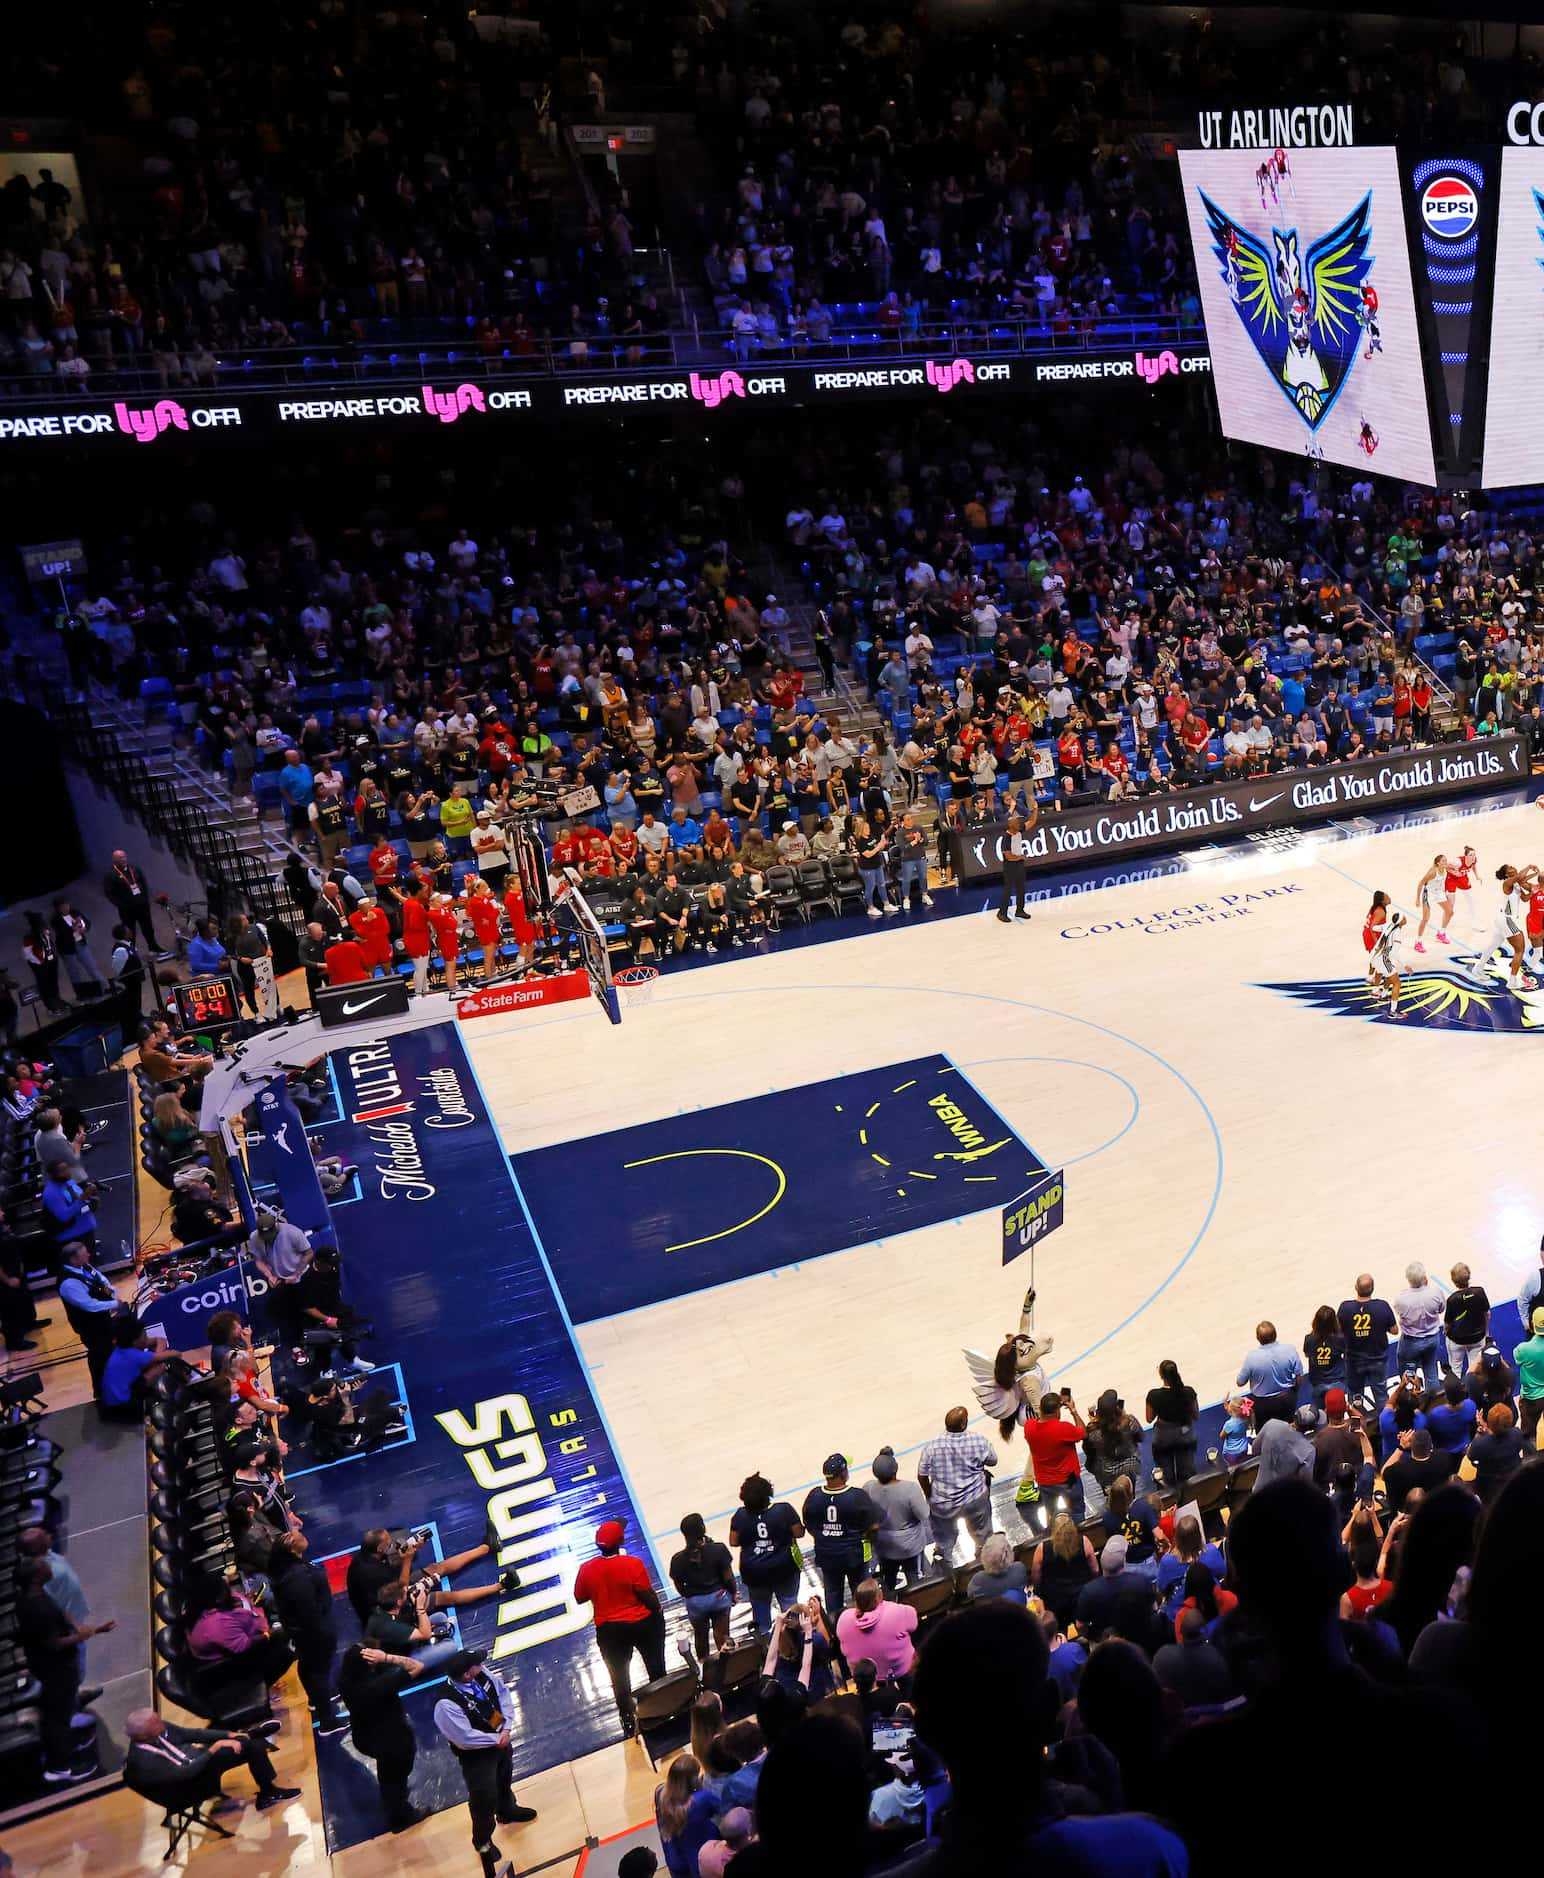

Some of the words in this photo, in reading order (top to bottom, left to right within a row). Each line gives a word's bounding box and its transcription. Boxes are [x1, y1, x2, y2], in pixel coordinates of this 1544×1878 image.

[1198, 111, 1222, 148] UT
[1229, 104, 1353, 148] ARLINGTON
[1426, 201, 1474, 214] PEPSI
[815, 371, 889, 390] PREPARE
[890, 368, 923, 386] FOR
[926, 358, 975, 392] lyft
[1036, 363, 1103, 381] PREPARE
[1103, 361, 1133, 378] FOR
[1135, 350, 1179, 384] lyft
[279, 398, 375, 420] PREPARE
[376, 397, 421, 416] FOR
[421, 383, 487, 423] lyft
[564, 385, 648, 405] PREPARE
[650, 383, 689, 400] FOR
[689, 371, 746, 407] lyft
[64, 414, 114, 435] FOR
[114, 399, 190, 442] lyft
[42, 560, 72, 576] UP!
[1292, 776, 1338, 810] Glad
[1340, 775, 1376, 800] You
[1378, 761, 1434, 792] Could
[1437, 756, 1476, 784] Join
[1476, 751, 1505, 776] Us.
[375, 807, 387, 819] 22
[1050, 824, 1093, 851] You
[1096, 810, 1161, 845] Could
[1165, 801, 1210, 833] Join
[1211, 796, 1243, 824] Us.
[605, 906, 621, 914] AT&T
[1059, 902, 1215, 939] COLLEGE
[1218, 883, 1304, 907] PARK
[1143, 907, 1254, 935] CENTER
[194, 1000, 225, 1022] 24
[262, 1102, 279, 1112] AT&T
[415, 1067, 477, 1129] Courtside
[928, 1092, 986, 1150] WNBA
[366, 1121, 436, 1201] Michelob
[1005, 1184, 1063, 1237] STAND
[1019, 1211, 1048, 1246] UP!
[181, 1275, 269, 1313] coinb
[1353, 1313, 1372, 1331] 22
[1316, 1347, 1332, 1360] 22
[433, 1393, 595, 1661] WINGS
[756, 1522, 769, 1539] 6
[826, 1505, 838, 1522] 0
